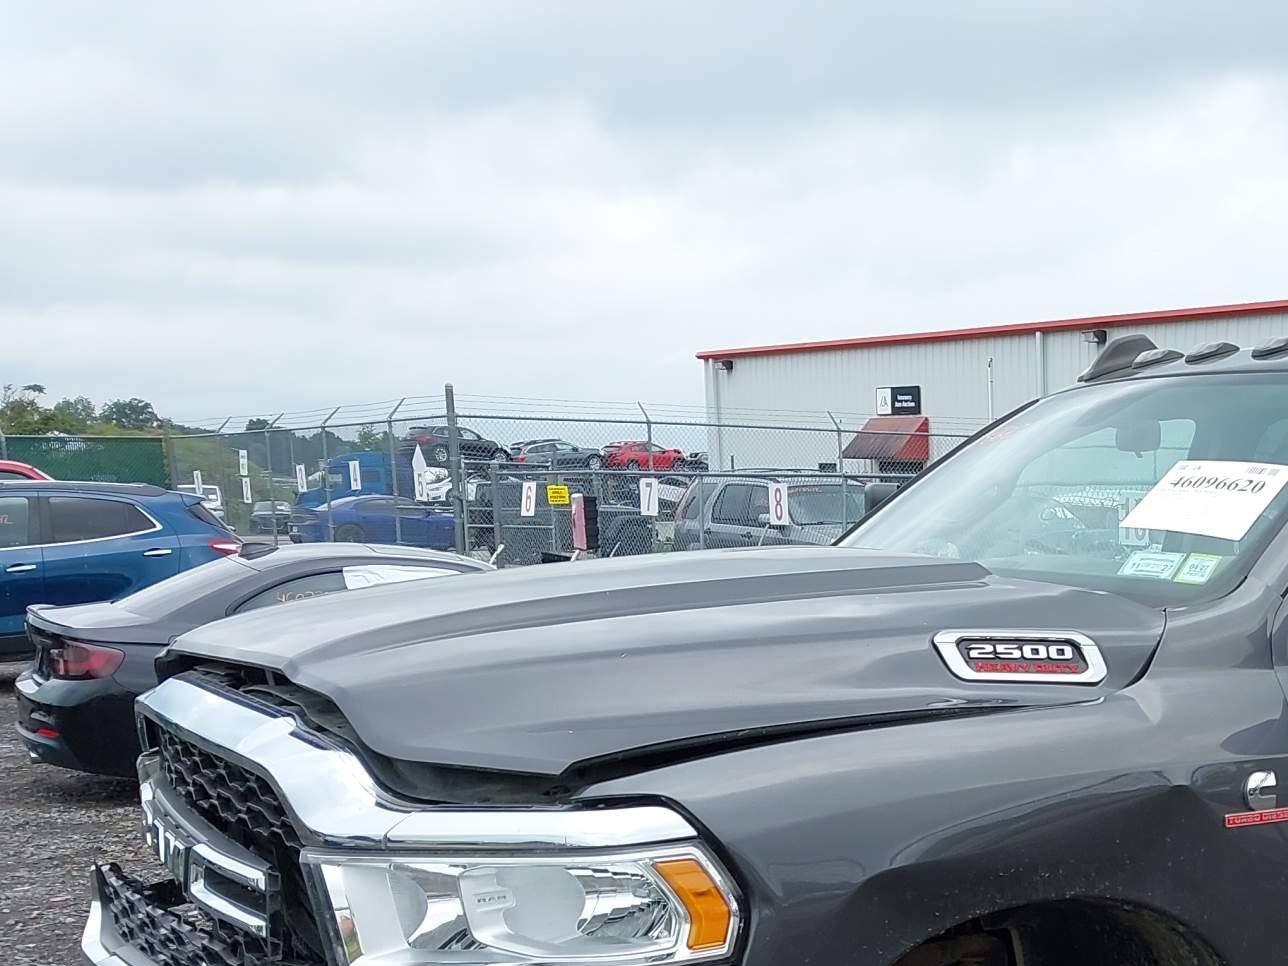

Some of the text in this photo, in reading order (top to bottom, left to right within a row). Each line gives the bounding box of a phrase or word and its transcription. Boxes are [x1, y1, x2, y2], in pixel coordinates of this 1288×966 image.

[417, 472, 424, 498] 5
[645, 482, 653, 512] 7
[1169, 475, 1267, 494] 46096620
[525, 485, 532, 512] 6
[774, 487, 783, 521] 8
[967, 643, 1073, 660] 2500
